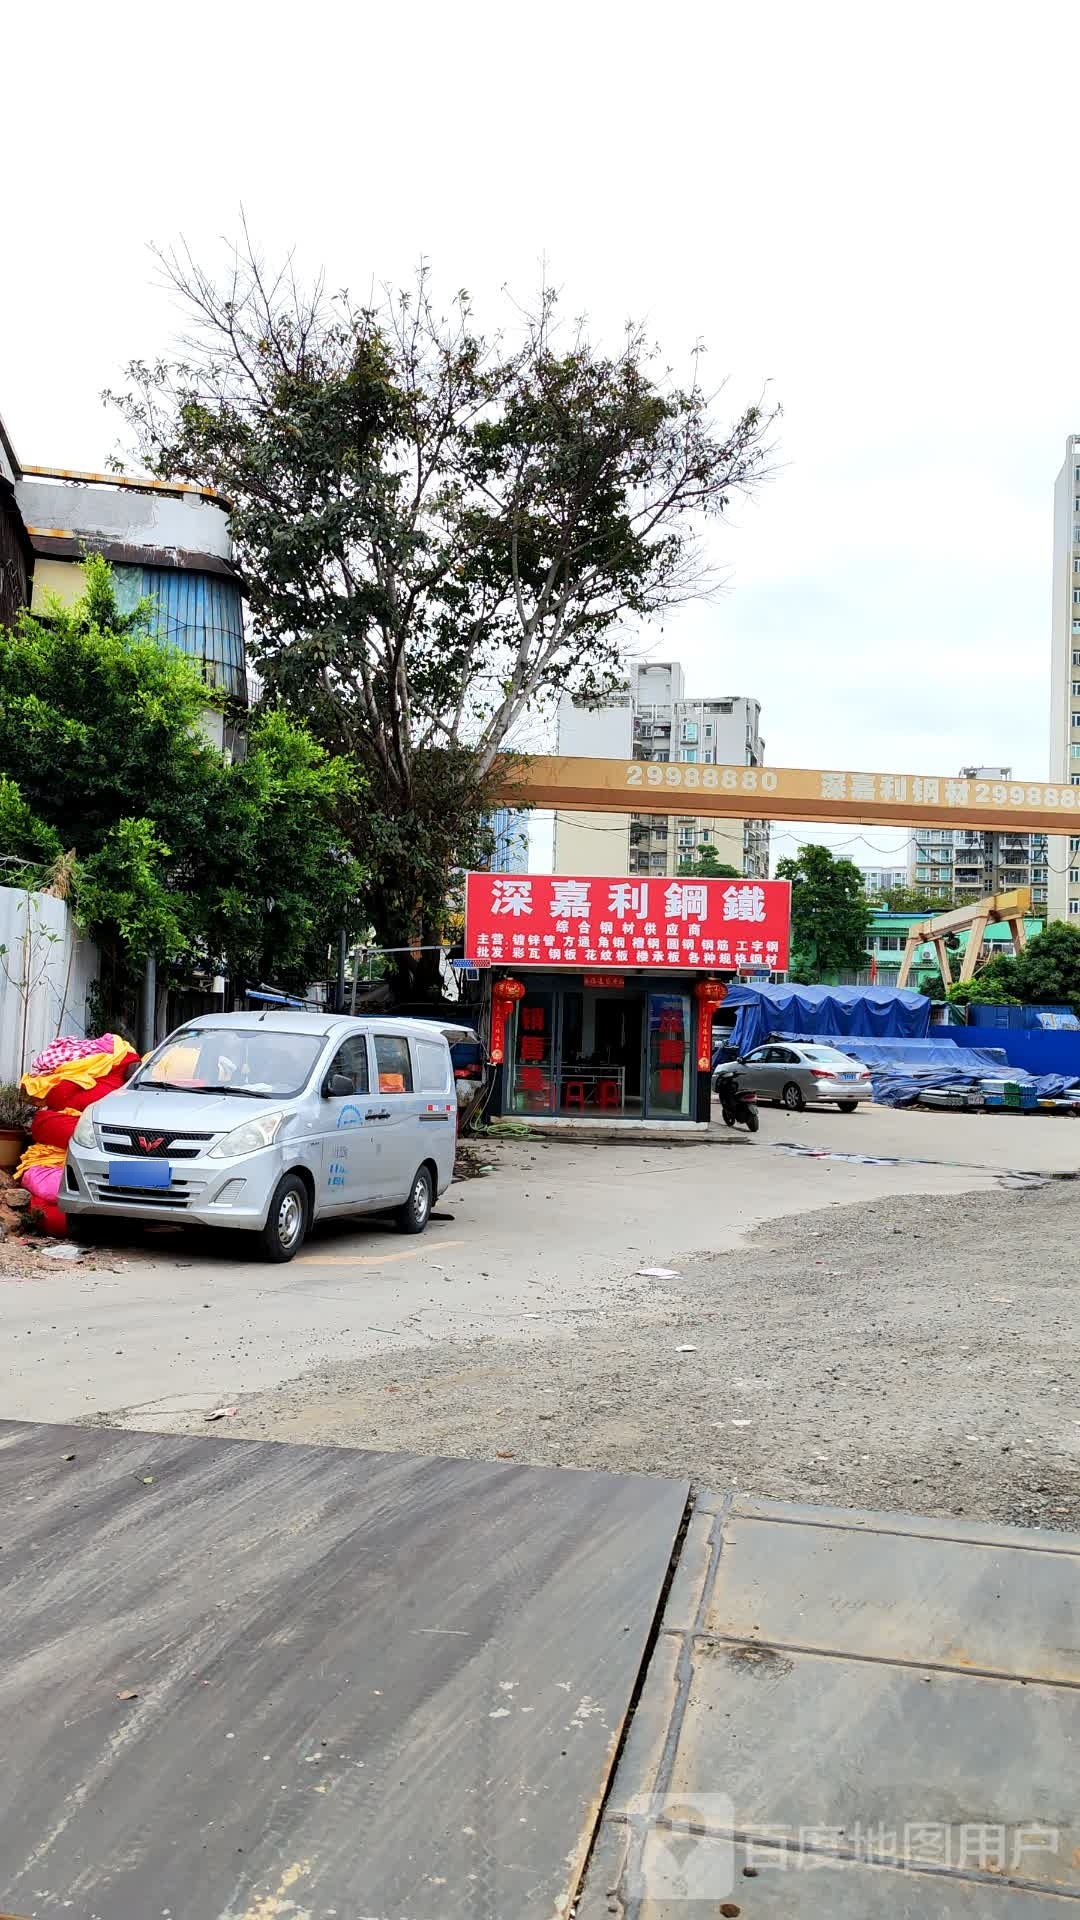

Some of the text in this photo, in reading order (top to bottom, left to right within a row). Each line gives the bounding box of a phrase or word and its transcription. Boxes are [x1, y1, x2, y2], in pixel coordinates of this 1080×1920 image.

[490, 879, 766, 922] 深嘉利鋼鐵
[555, 920, 701, 937] 综合钢材供应商
[512, 934, 555, 947] 镀锌管
[563, 935, 590, 948] 方通
[598, 936, 624, 949] 角钢
[631, 937, 659, 950] 槽钢
[666, 938, 694, 951] 圆钢
[701, 938, 728, 952] 钢筋
[736, 939, 778, 953] 工字钢
[512, 946, 540, 960] 彩瓦
[548, 947, 576, 961] 钢板
[584, 948, 627, 962] 花纹板
